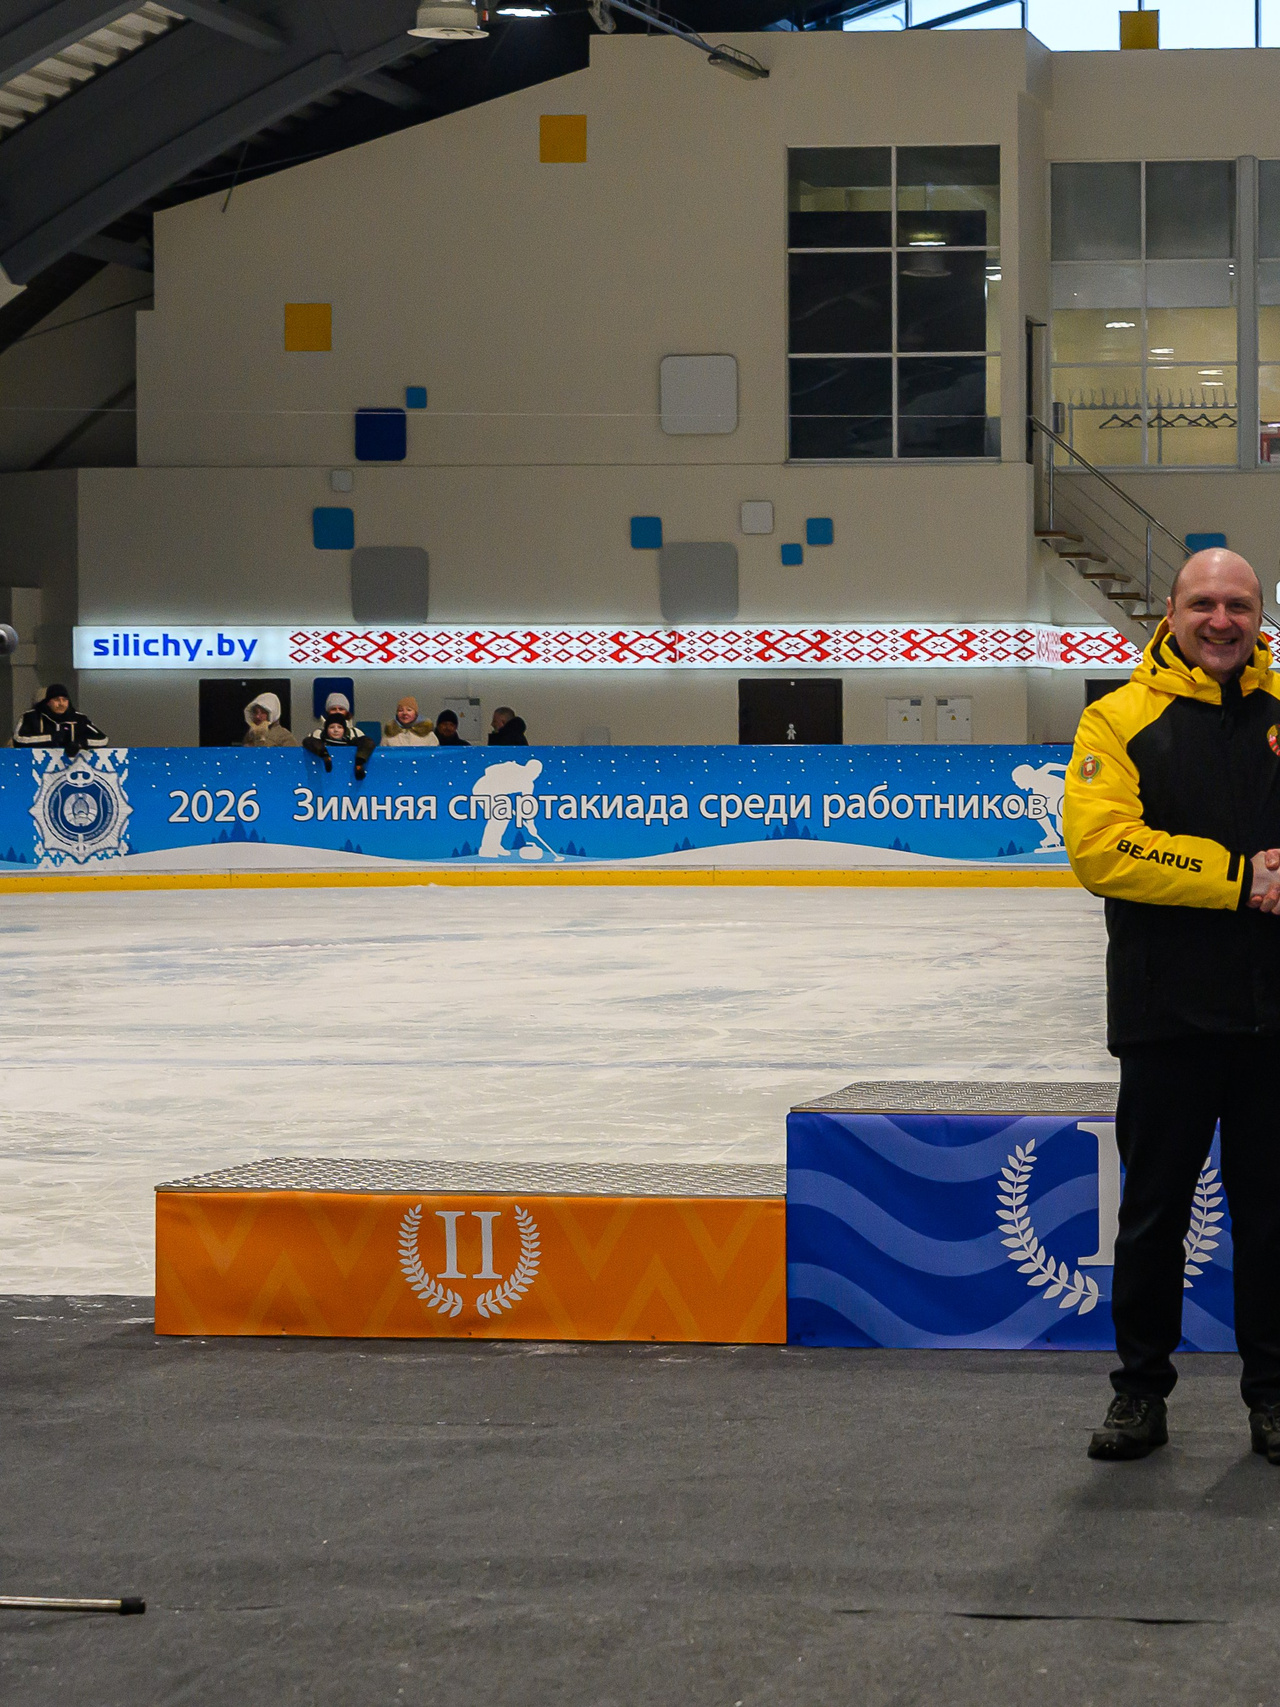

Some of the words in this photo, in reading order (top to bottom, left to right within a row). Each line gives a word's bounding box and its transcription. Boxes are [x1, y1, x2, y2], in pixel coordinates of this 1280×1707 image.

[93, 633, 258, 662] silichy.by
[168, 789, 260, 823] 2026
[292, 787, 437, 821] Зимняя
[448, 793, 689, 828] спартакиада
[699, 793, 811, 828] среди
[822, 784, 1048, 828] работников
[435, 1211, 503, 1279] II
